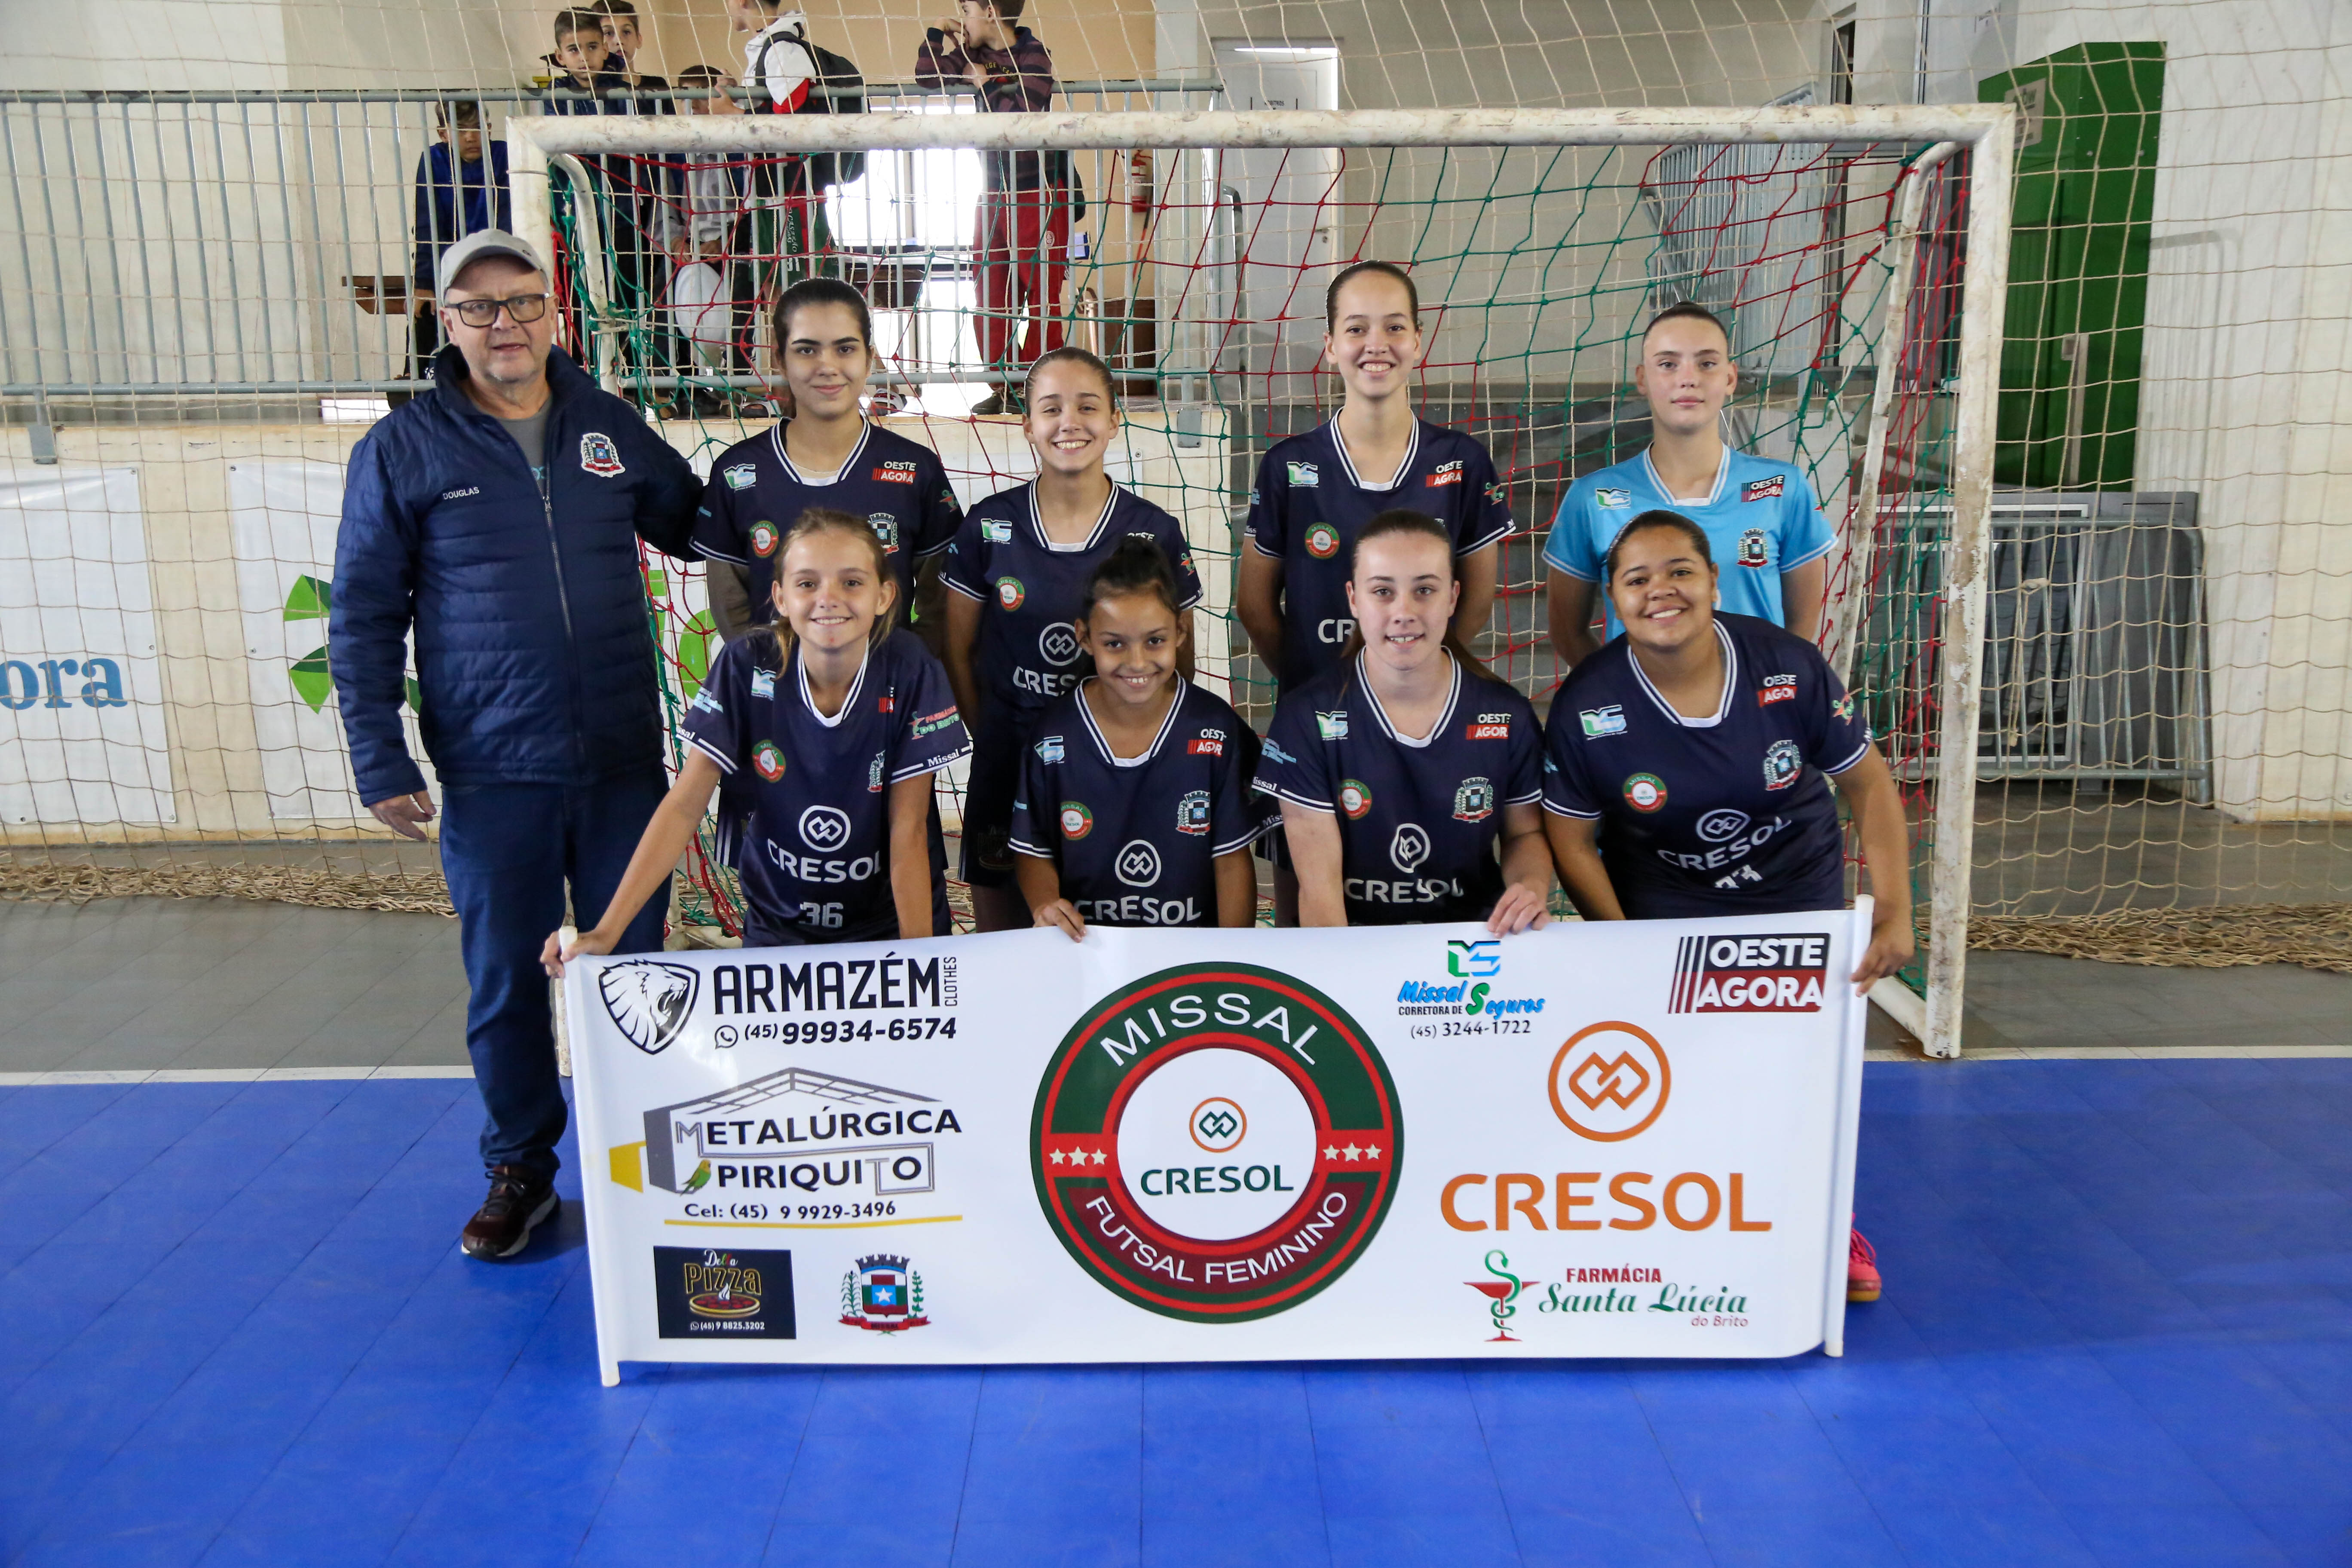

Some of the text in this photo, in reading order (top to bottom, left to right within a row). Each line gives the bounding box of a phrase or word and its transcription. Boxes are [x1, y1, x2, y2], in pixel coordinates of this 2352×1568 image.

[881, 471, 913, 483] AGORA
[884, 461, 916, 471] OESTE
[443, 487, 480, 500] DOUGLAS
[1749, 486, 1782, 501] AGORA
[1751, 475, 1784, 490] OESTE
[927, 748, 960, 767] Missal
[1657, 816, 1792, 870] CRESOL
[767, 838, 881, 883] CRESOL
[1344, 878, 1464, 903] CRESOL
[798, 902, 843, 928] 36
[1074, 895, 1201, 925] CRESOL
[1709, 938, 1825, 968] OESTE
[713, 951, 958, 1015] ARMAZÉM CLOTHES
[1697, 976, 1823, 1007] AGORA
[1397, 980, 1546, 1020] Missal Seguros
[1398, 1005, 1463, 1015] CORRETORA DE
[1100, 993, 1319, 1067] MISSAL
[1411, 1020, 1531, 1039] (45) 3244-1722
[674, 1105, 962, 1146] METALÚRGICA
[717, 1155, 923, 1193] PIRIQUITO
[1140, 1164, 1295, 1196] CRESOL
[684, 1203, 724, 1219] Cel:
[729, 1203, 769, 1221] (45)
[797, 1201, 896, 1221] 9929-3496
[1440, 1171, 1773, 1232] CRESOL
[1085, 1191, 1348, 1284] FUTSAL FEMININO
[704, 1248, 738, 1267] Della
[1566, 1263, 1662, 1283] FARMÁCIA
[1539, 1282, 1750, 1314] Santa Lúcia
[700, 1321, 715, 1332] (45)
[1691, 1315, 1749, 1327] do Brito
